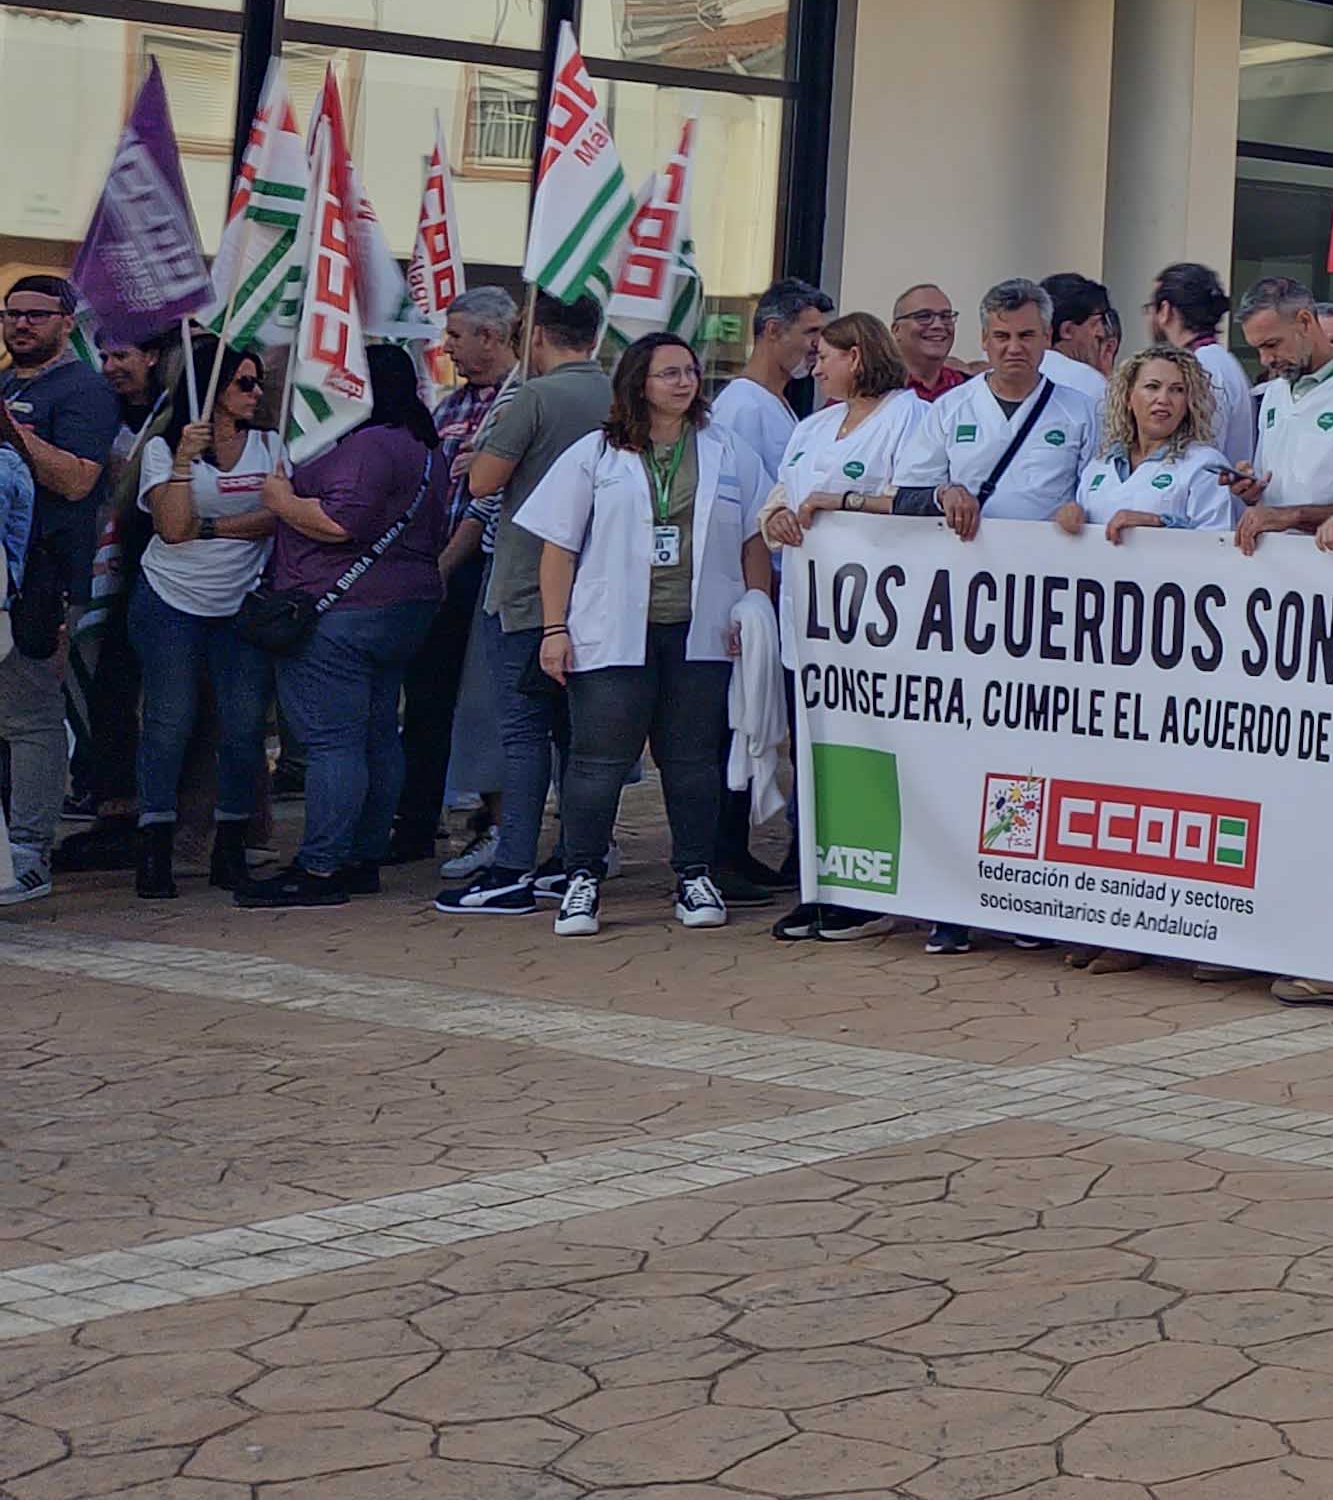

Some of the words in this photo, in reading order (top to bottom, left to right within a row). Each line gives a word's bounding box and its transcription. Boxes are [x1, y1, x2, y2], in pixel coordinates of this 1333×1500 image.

[806, 559, 906, 648] LOS
[916, 568, 1226, 673] ACUERDOS
[801, 663, 973, 731] CONSEJERA,
[983, 680, 1104, 737] CUMPLE
[1113, 692, 1149, 742] EL
[1160, 696, 1290, 757] ACUERDO
[1298, 710, 1331, 763] DE
[1057, 797, 1213, 864] CCOO
[978, 861, 1069, 889] federación
[1075, 872, 1096, 892] de
[1101, 878, 1166, 902] sanidad
[1171, 889, 1181, 907] y
[1185, 891, 1254, 915] sectores
[980, 892, 1105, 924] sociosanitarios
[1110, 907, 1131, 928] de
[1134, 911, 1218, 941] Andalucía
